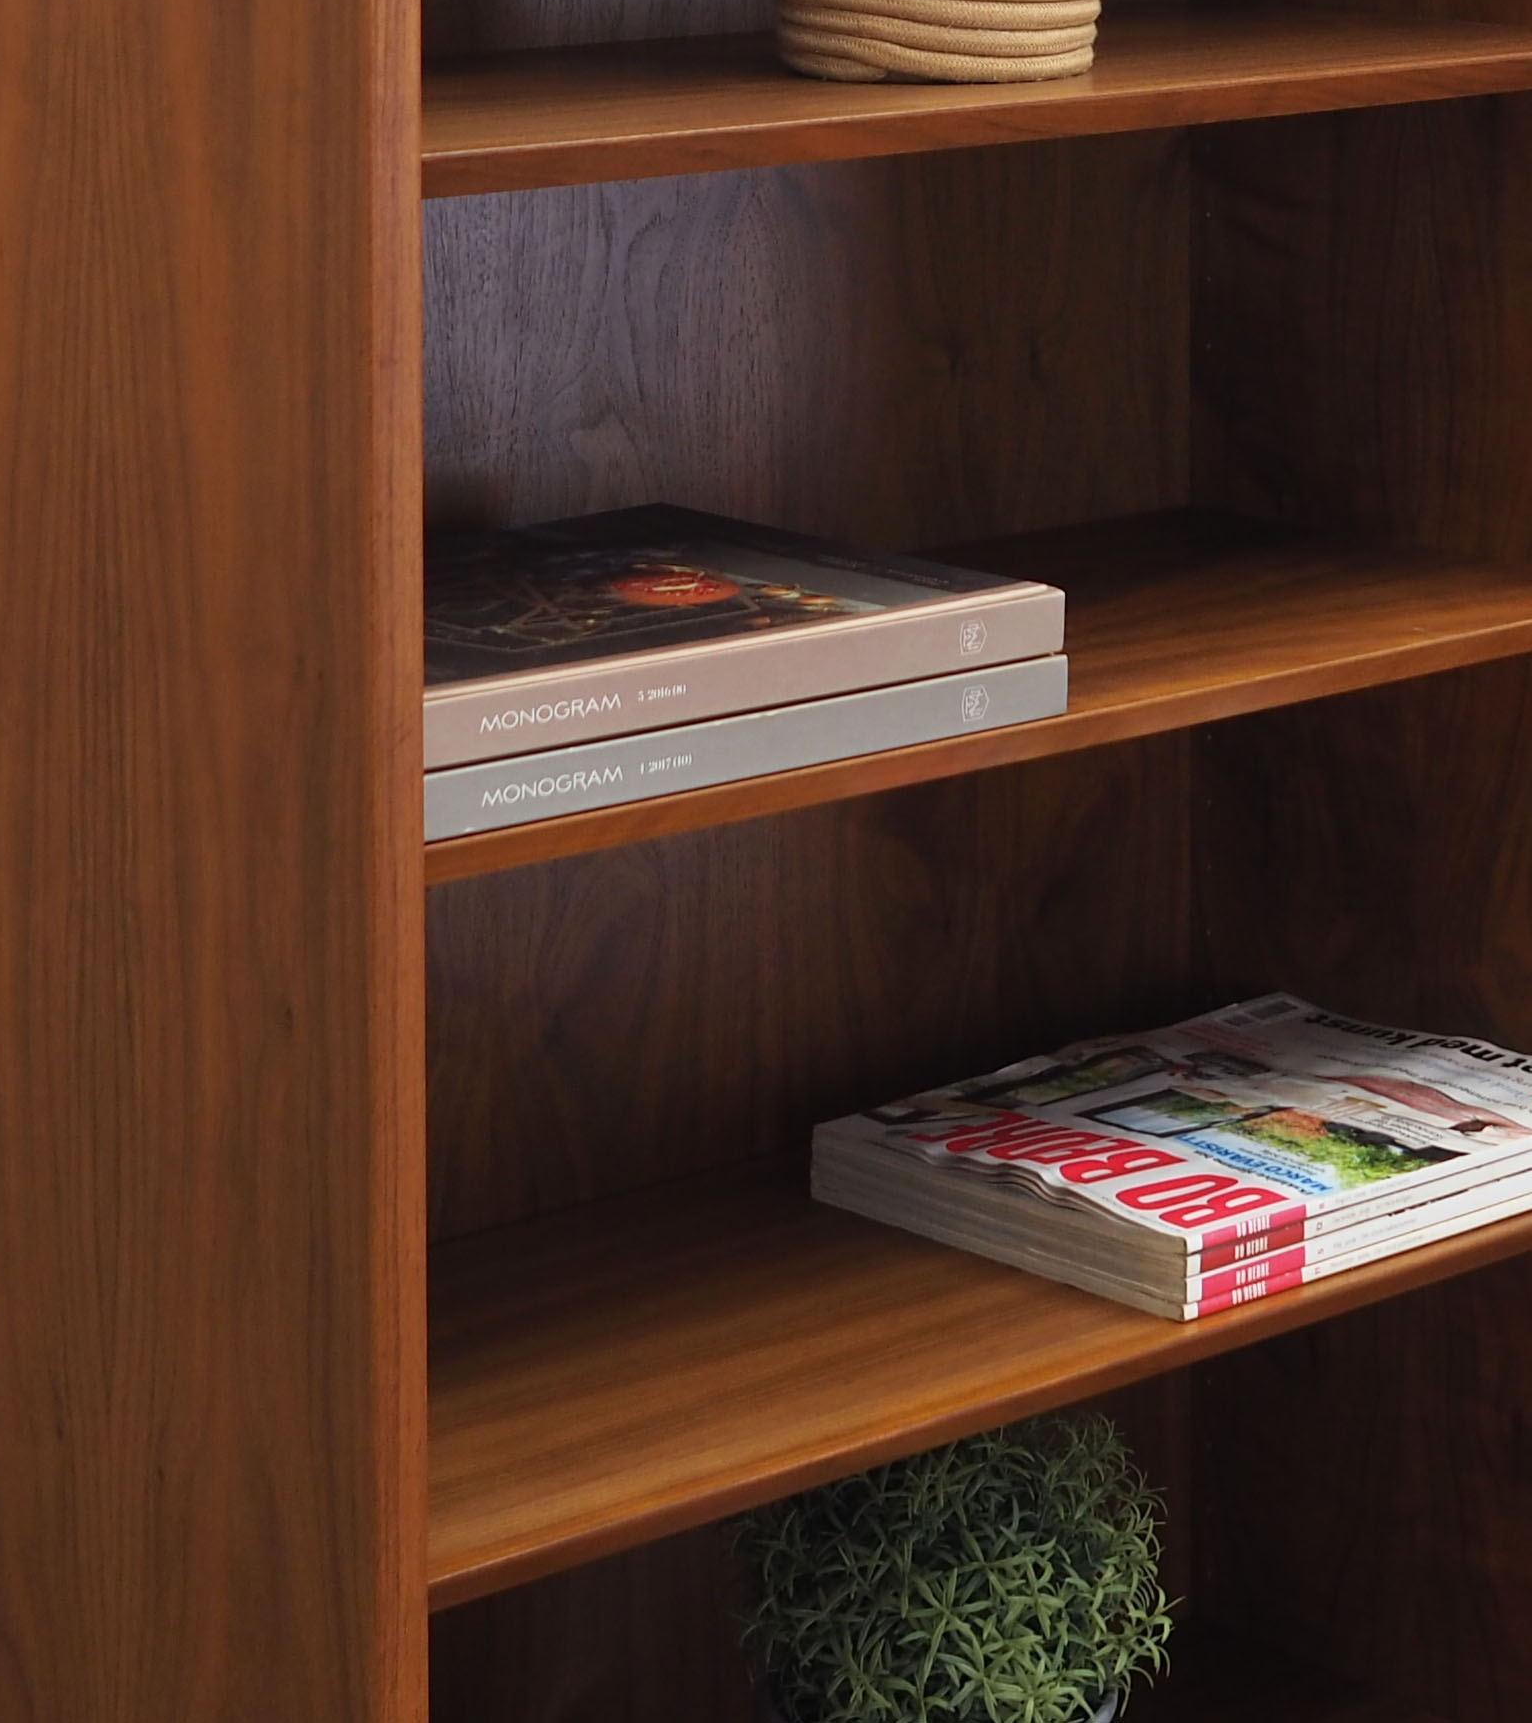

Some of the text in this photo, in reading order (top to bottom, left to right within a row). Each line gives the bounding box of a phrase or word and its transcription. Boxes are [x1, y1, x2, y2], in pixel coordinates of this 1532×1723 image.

[479, 693, 622, 733] MONOGRAM
[481, 765, 623, 808] MONOGRAM
[1406, 1038, 1506, 1062] med
[908, 1110, 1188, 1184] BEDRE
[1266, 1166, 1333, 1191] MARCO
[1115, 1174, 1290, 1229] BO
